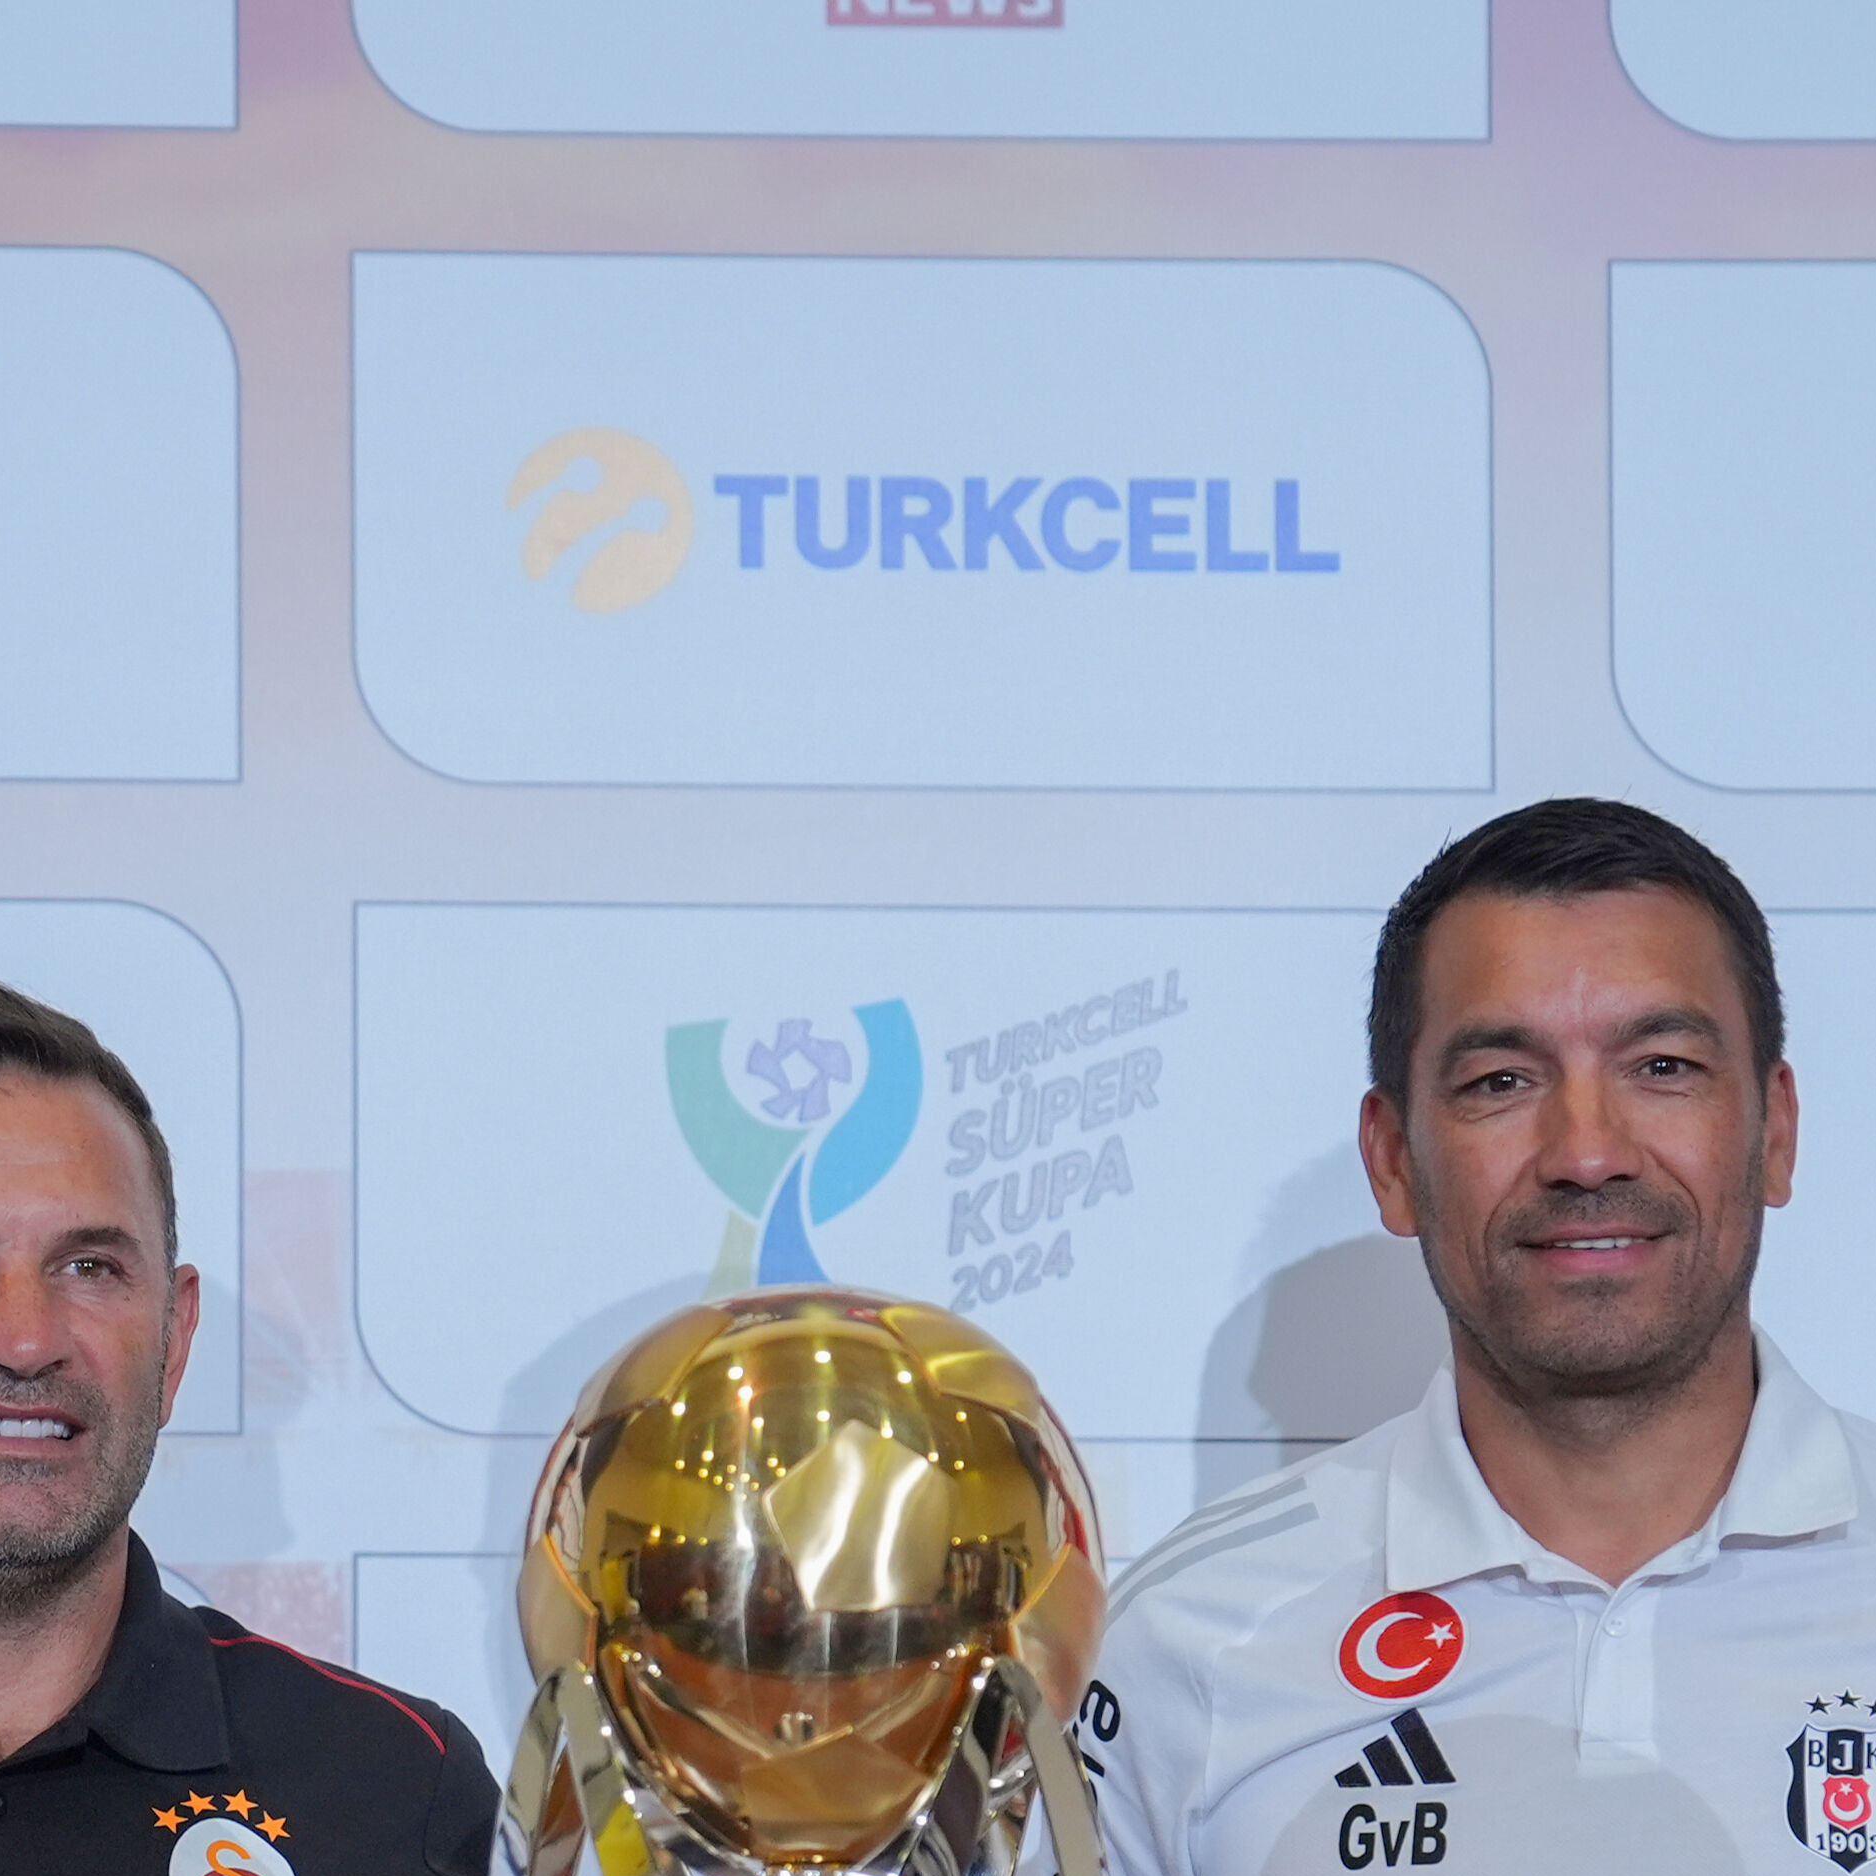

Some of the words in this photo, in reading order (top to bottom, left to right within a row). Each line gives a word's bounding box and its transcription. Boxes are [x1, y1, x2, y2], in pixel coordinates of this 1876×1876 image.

[713, 473, 1341, 574] TURKCELL
[944, 968, 1189, 1096] TURKCELL
[945, 1046, 1164, 1179] SÜPER
[946, 1135, 1134, 1257] KUPA
[949, 1229, 1075, 1314] 2024
[1337, 1801, 1448, 1871] GvB
